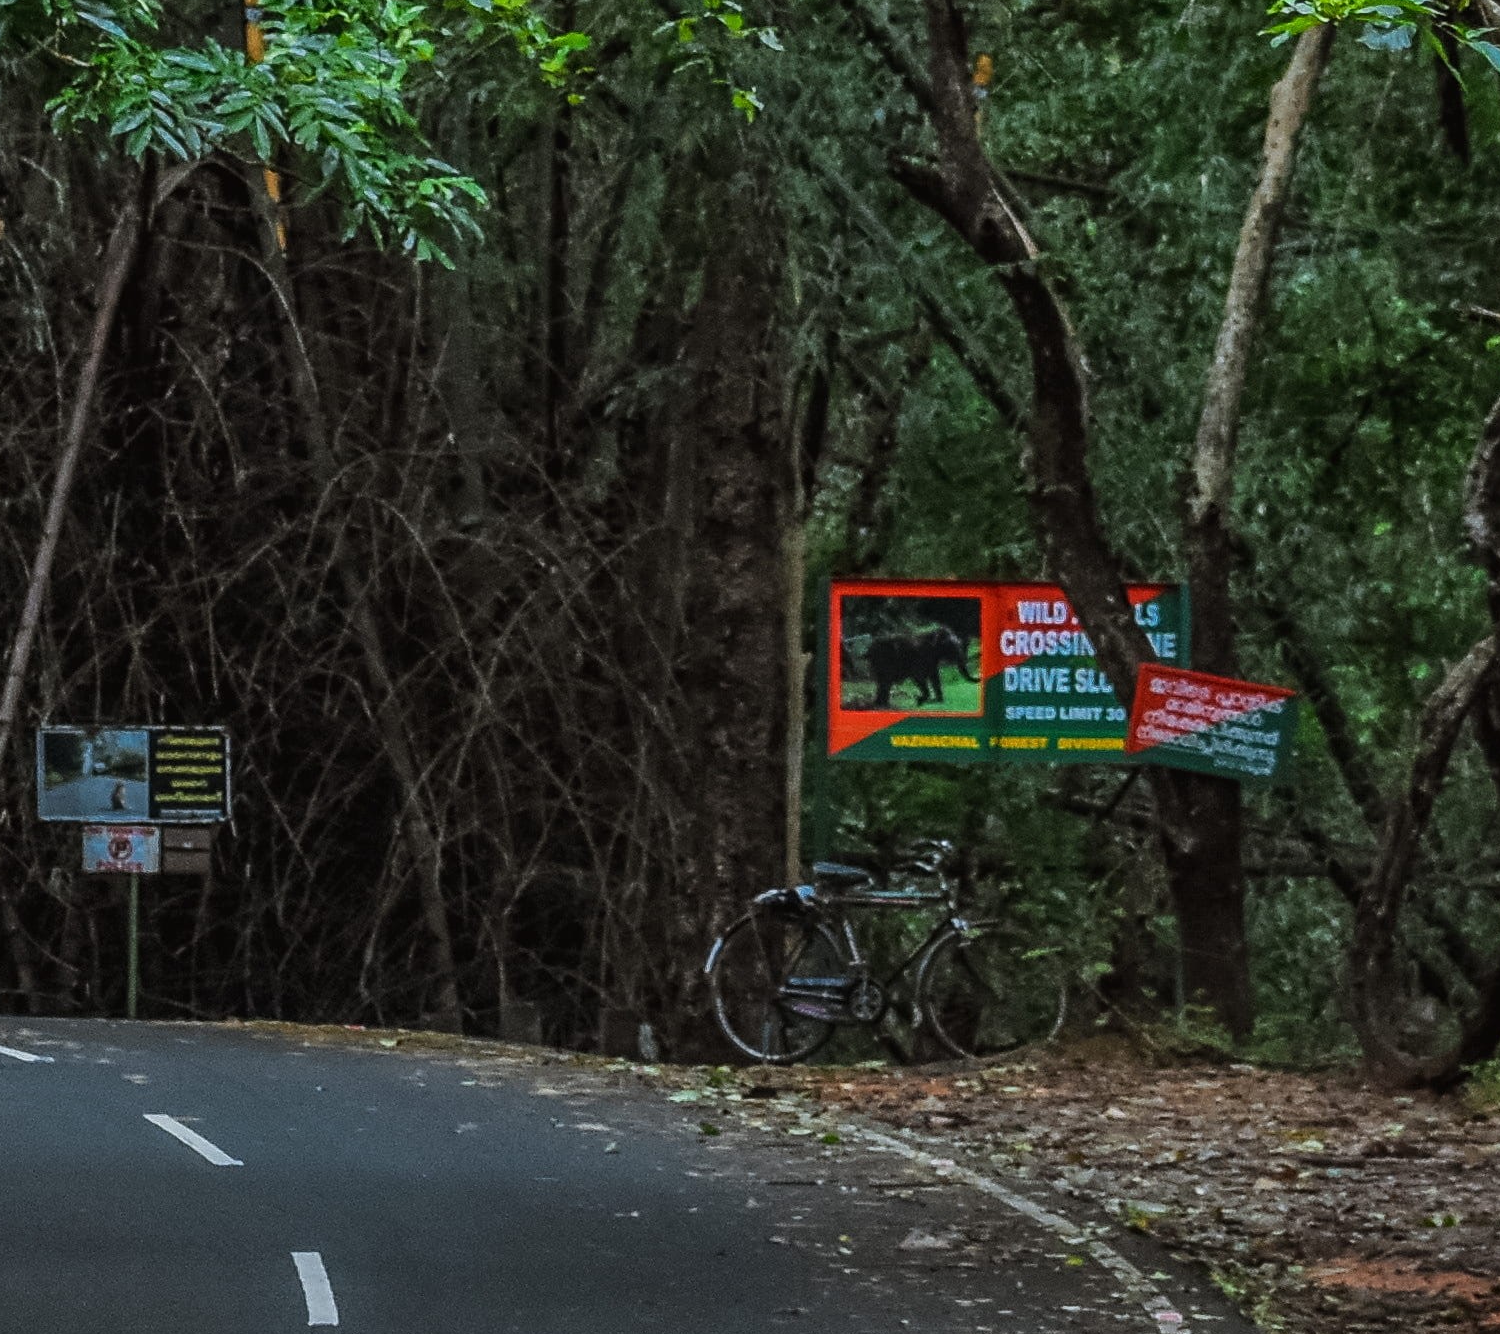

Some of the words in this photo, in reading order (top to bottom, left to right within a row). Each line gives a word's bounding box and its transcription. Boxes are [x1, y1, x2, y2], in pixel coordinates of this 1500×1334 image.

[1016, 600, 1068, 625] WILD
[1000, 629, 1098, 656] CROSSIN
[1004, 666, 1071, 693] DRIVE
[1005, 706, 1057, 720] SPEED
[1059, 706, 1103, 720] LIMIT
[1105, 707, 1127, 722] 30
